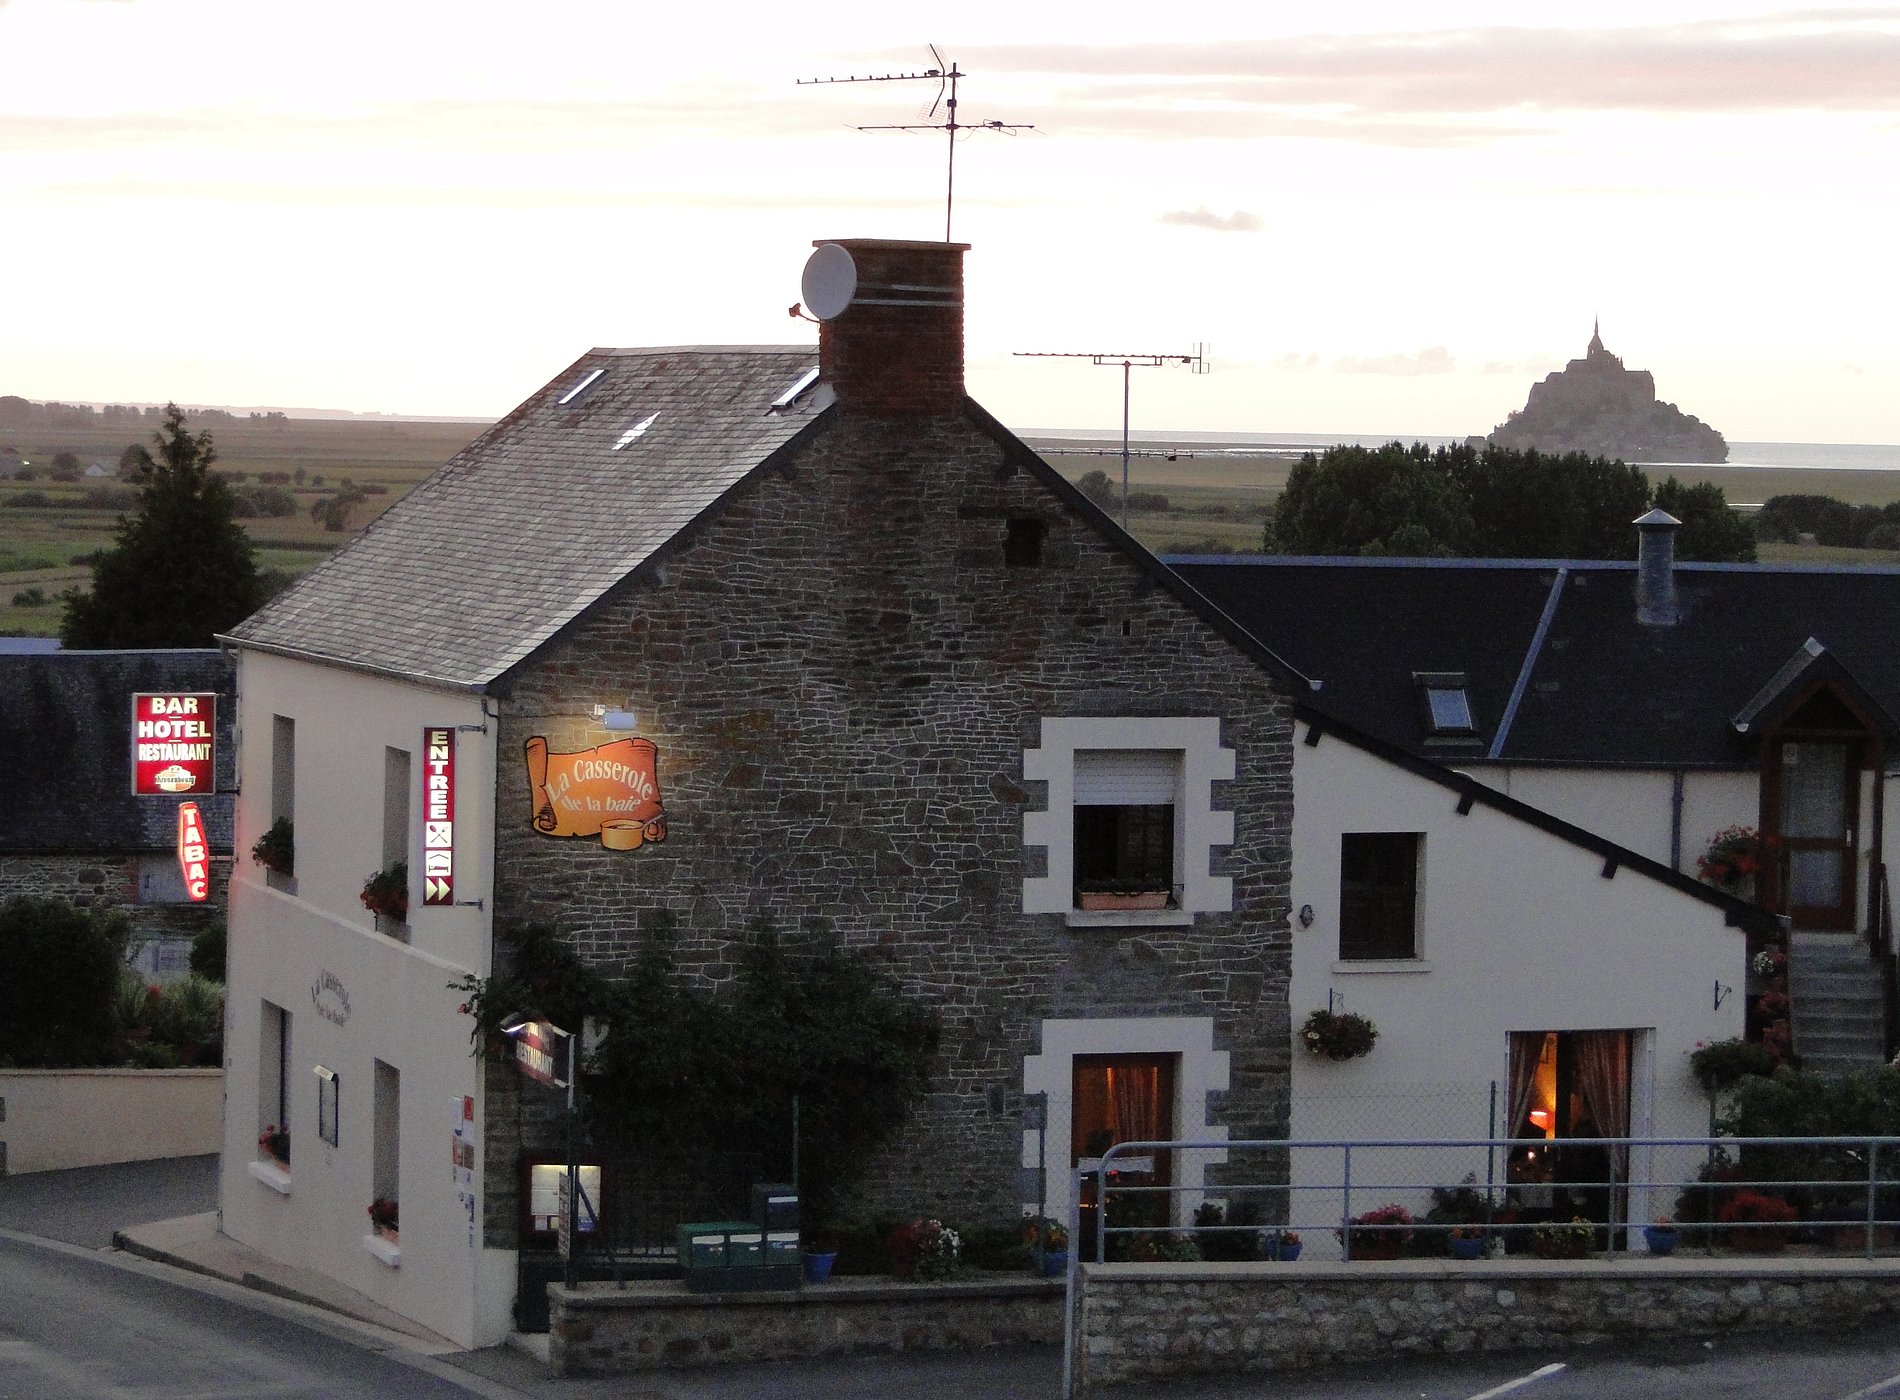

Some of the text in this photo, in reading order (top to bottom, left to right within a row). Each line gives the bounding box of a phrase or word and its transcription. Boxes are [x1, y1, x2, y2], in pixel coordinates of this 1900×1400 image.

[152, 697, 198, 714] BAR
[138, 720, 212, 738] HOTEL
[138, 743, 211, 762] RESTAURANT
[430, 731, 449, 819] ENTREE
[545, 759, 654, 802] La Casserole
[561, 795, 642, 812] de la baie
[183, 808, 206, 899] TABAC
